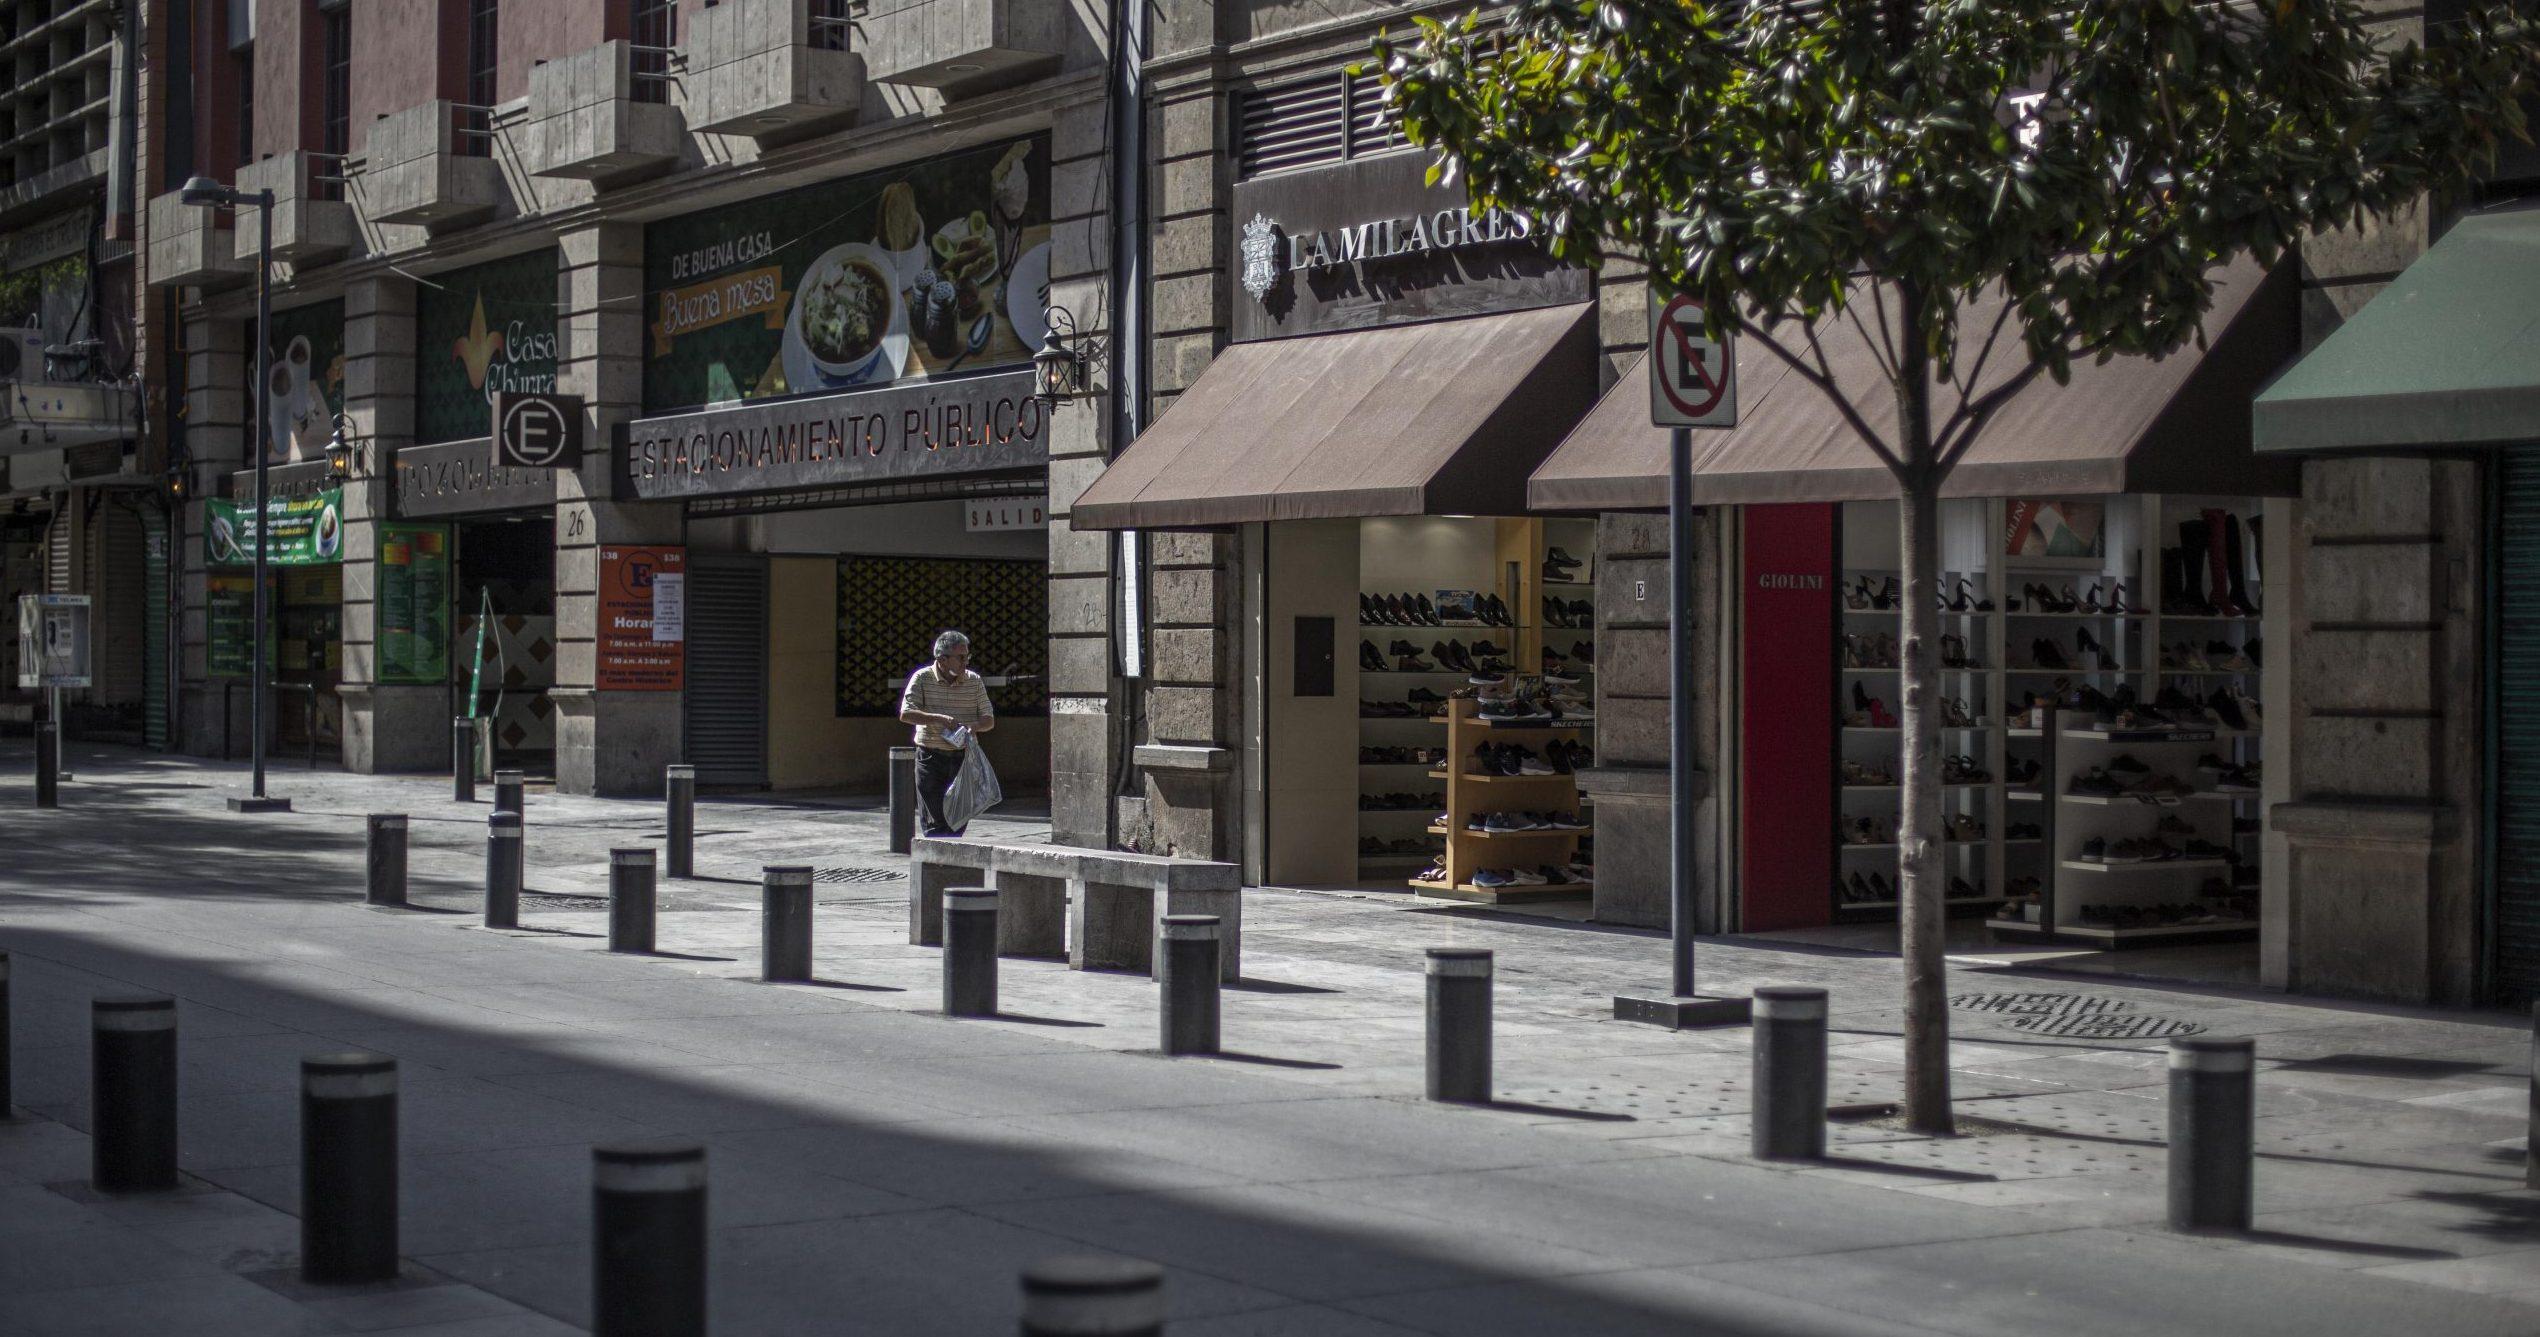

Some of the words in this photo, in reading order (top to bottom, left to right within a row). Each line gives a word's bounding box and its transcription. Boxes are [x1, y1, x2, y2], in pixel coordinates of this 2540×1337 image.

[672, 253, 689, 280] DE
[691, 240, 736, 276] BUENA
[737, 230, 773, 262] CASA
[664, 289, 721, 334] Buena
[726, 274, 775, 314] mesa
[506, 320, 558, 363] Casa
[519, 410, 550, 454] E
[628, 412, 886, 479] ESTACIONAMIENTO
[903, 396, 1042, 454] PÚBLICO
[567, 510, 585, 537] 26
[1759, 572, 1823, 590] GIOLINI
